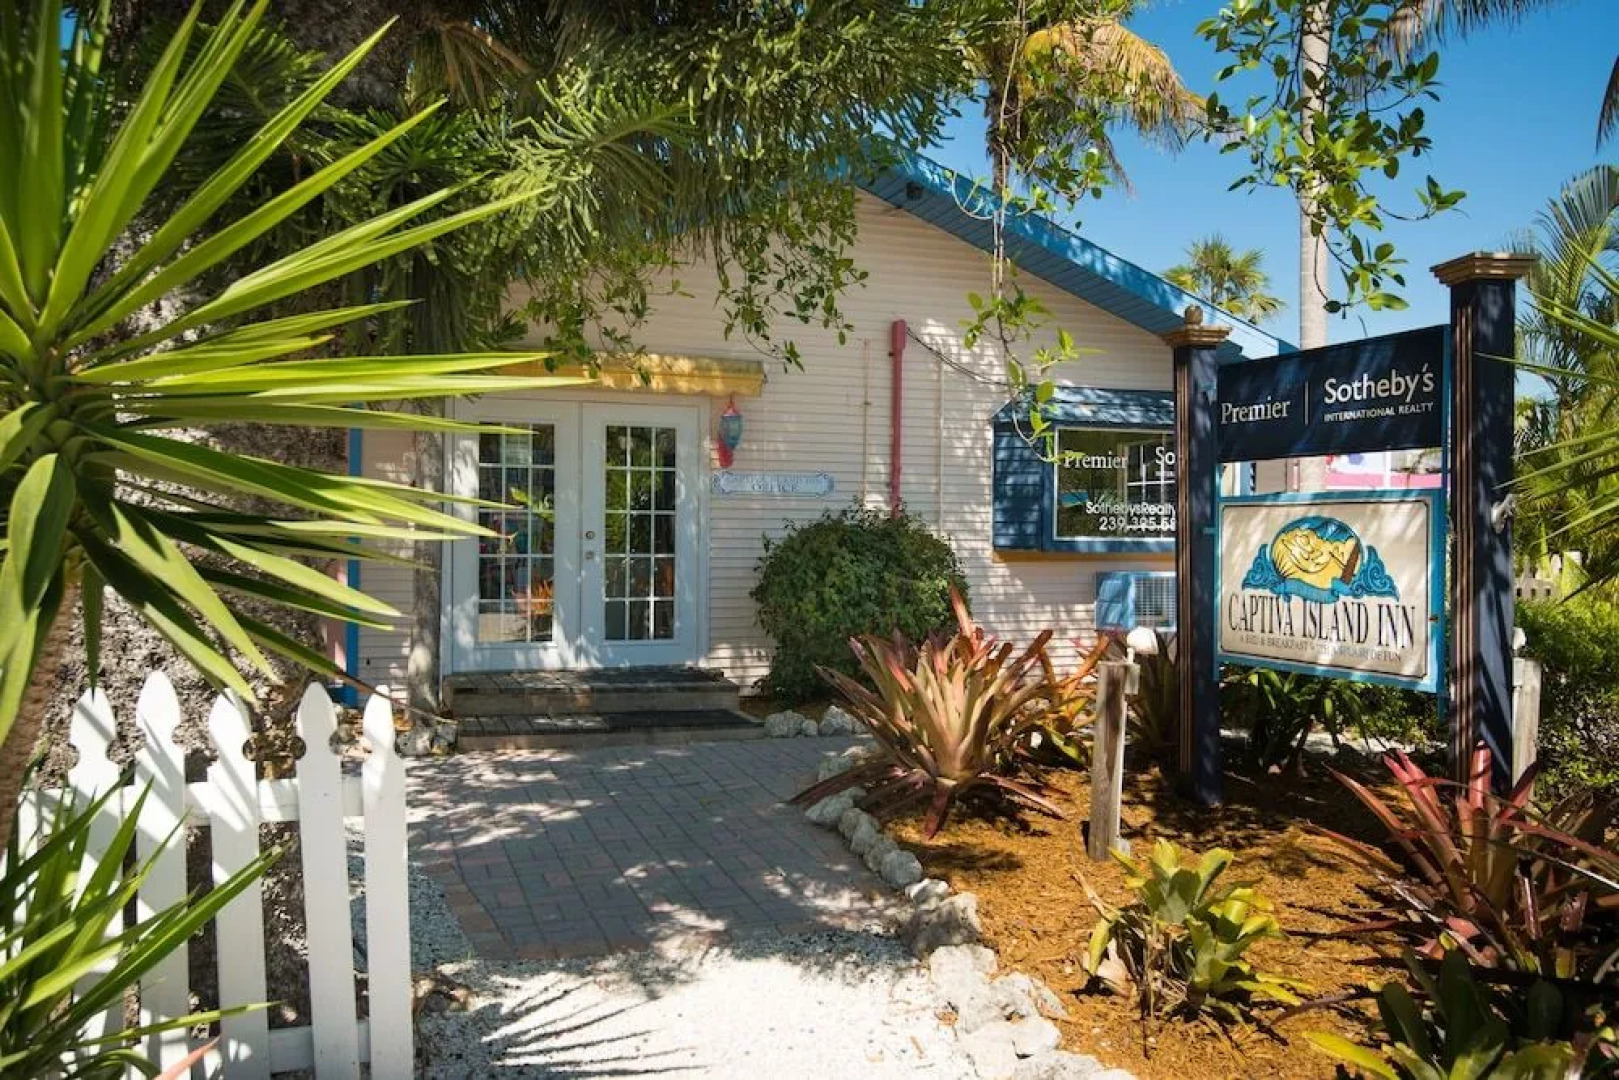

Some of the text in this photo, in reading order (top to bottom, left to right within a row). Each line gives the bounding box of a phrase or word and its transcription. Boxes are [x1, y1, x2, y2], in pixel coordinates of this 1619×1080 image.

[1221, 363, 1435, 424] Premier Sotheby's
[1324, 401, 1434, 422] INTERNATIONAL REALTY
[1228, 593, 1416, 649] CAPTIVA ISLAND INN
